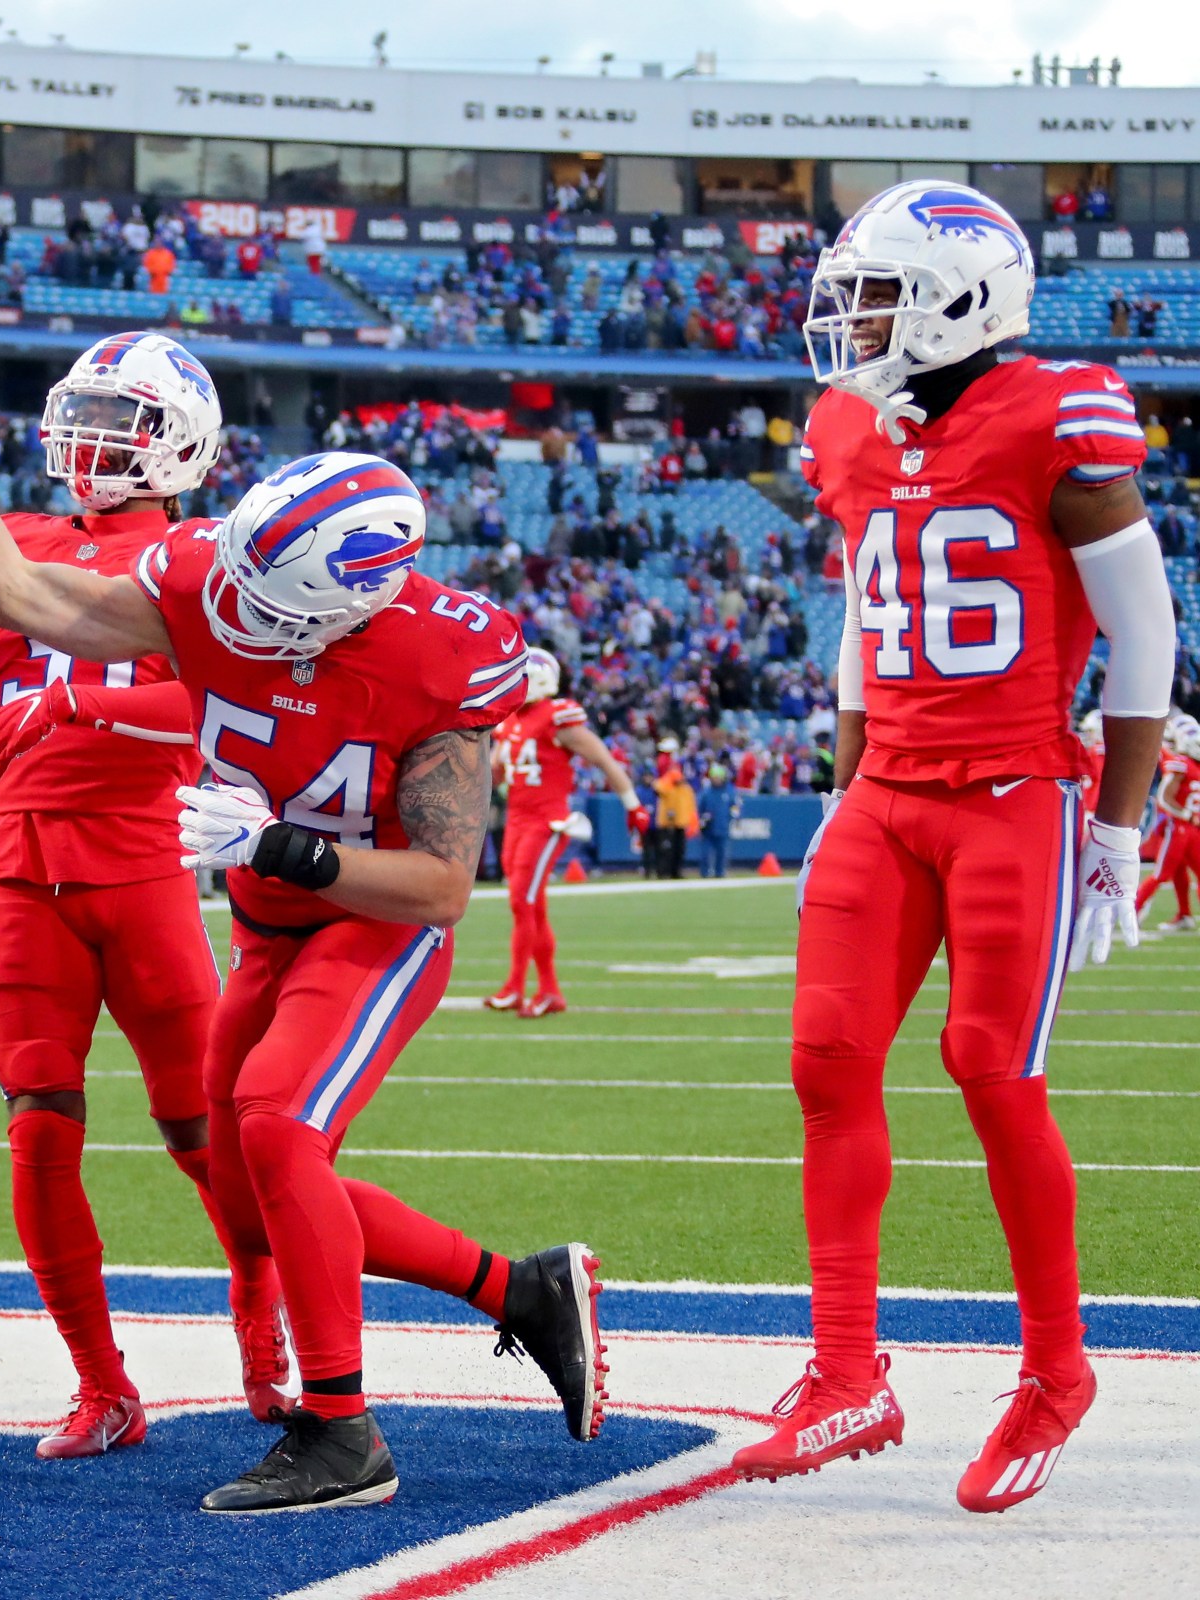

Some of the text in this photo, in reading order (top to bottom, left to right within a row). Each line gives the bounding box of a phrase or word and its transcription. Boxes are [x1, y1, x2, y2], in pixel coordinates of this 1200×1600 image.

[31, 78, 116, 97] TALLEY
[208, 92, 265, 107] FRED
[496, 106, 544, 119] BOB
[556, 108, 637, 122] KALSU
[726, 114, 772, 127] JOE
[1040, 118, 1195, 132] MARV LEVY
[200, 203, 257, 236] 240
[891, 485, 931, 500] BILLS
[854, 504, 1025, 679] 46
[271, 694, 317, 716] BILLS
[199, 688, 376, 849] 54
[1099, 858, 1124, 898] adidas
